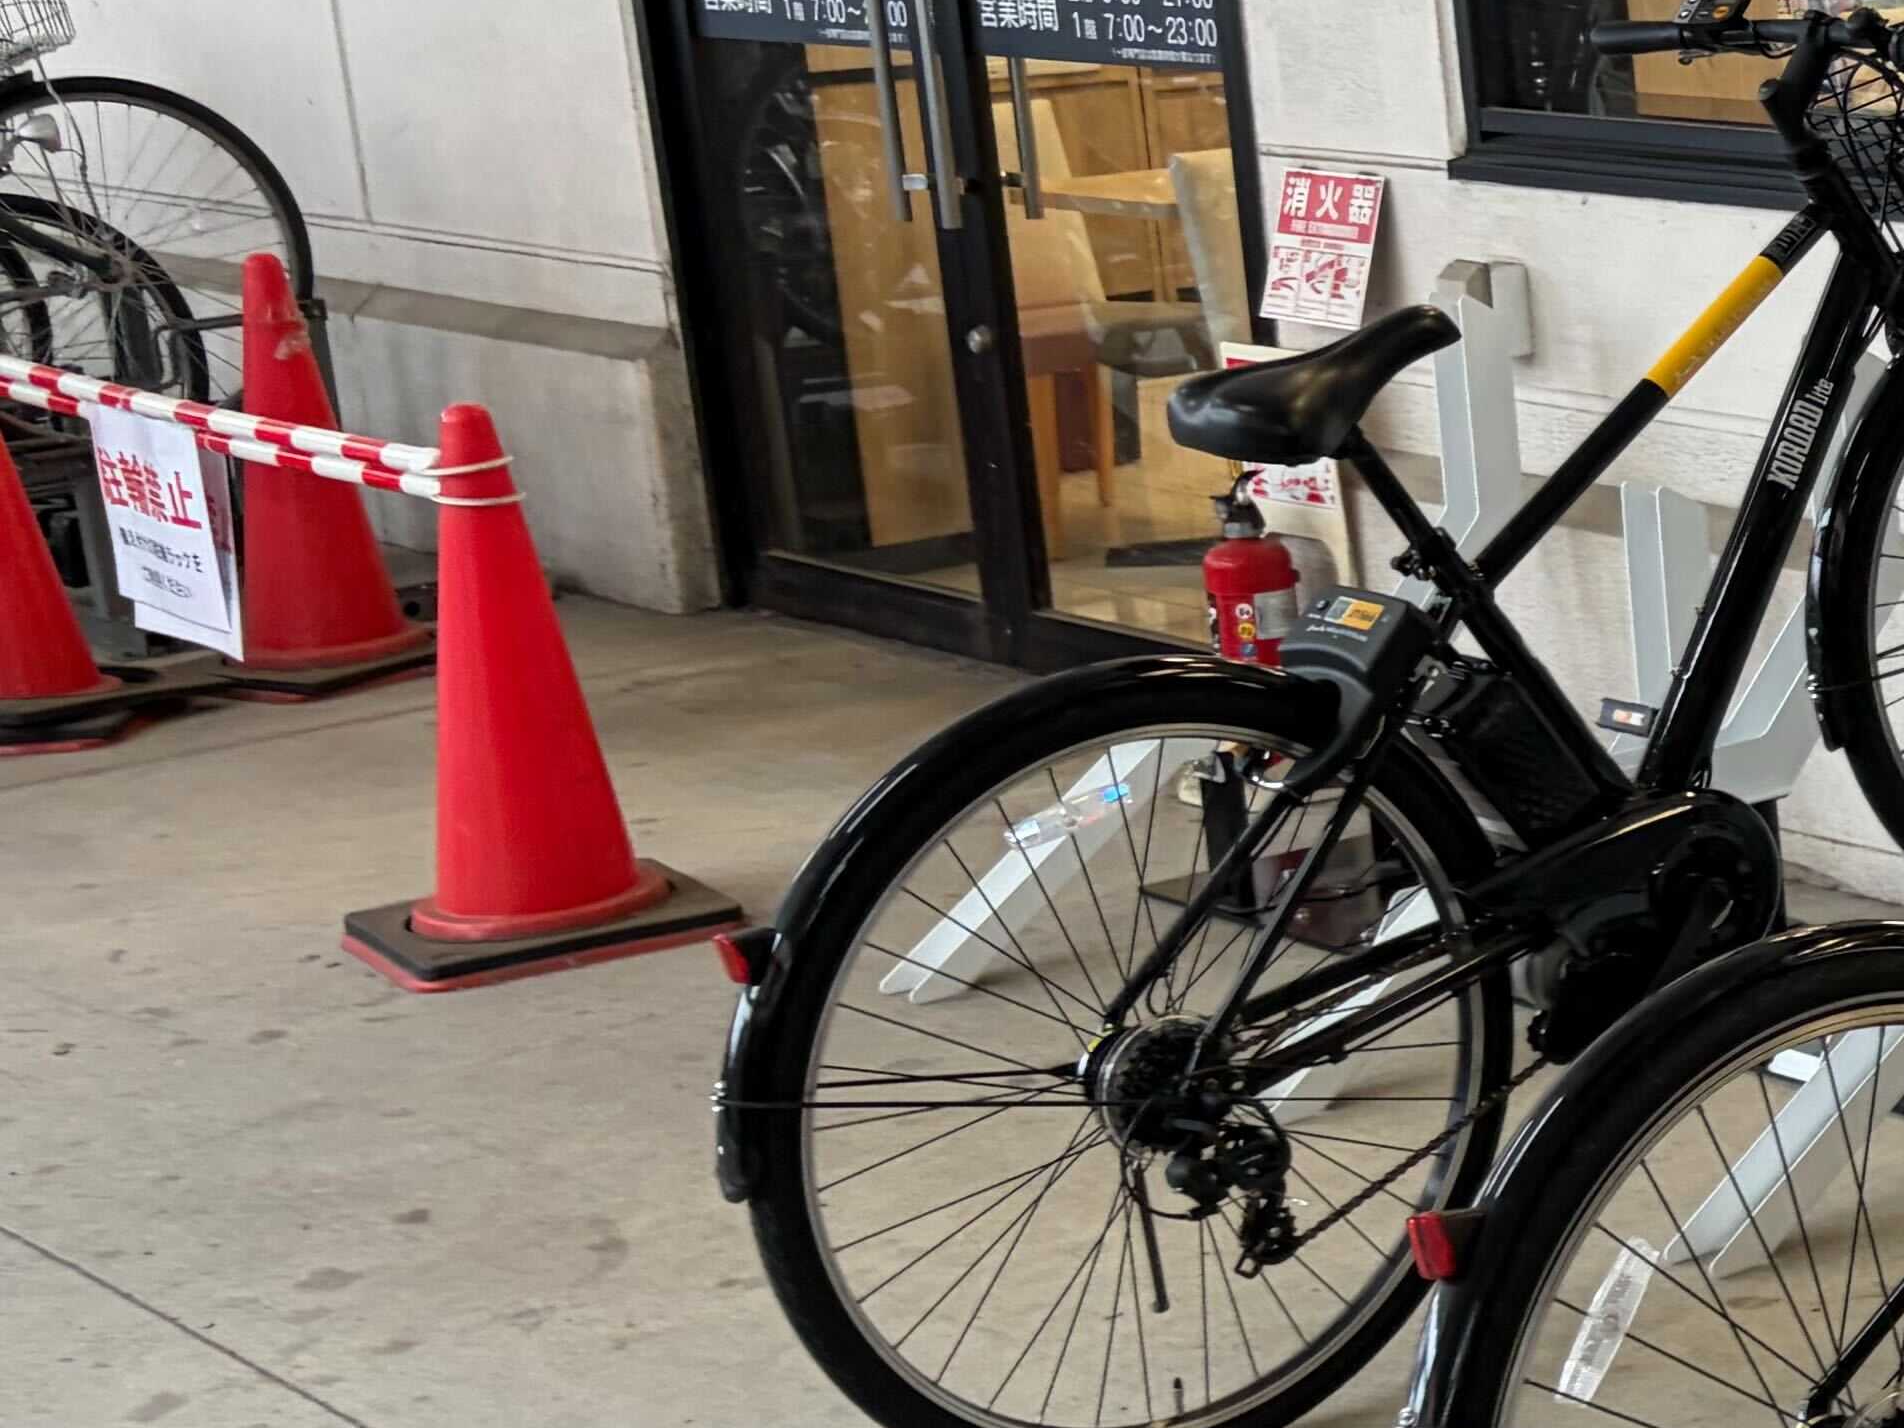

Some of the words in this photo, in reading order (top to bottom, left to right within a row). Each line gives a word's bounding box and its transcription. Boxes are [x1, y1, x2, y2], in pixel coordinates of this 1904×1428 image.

[1072, 12, 1098, 39] 1階
[1283, 177, 1375, 225] 消火器
